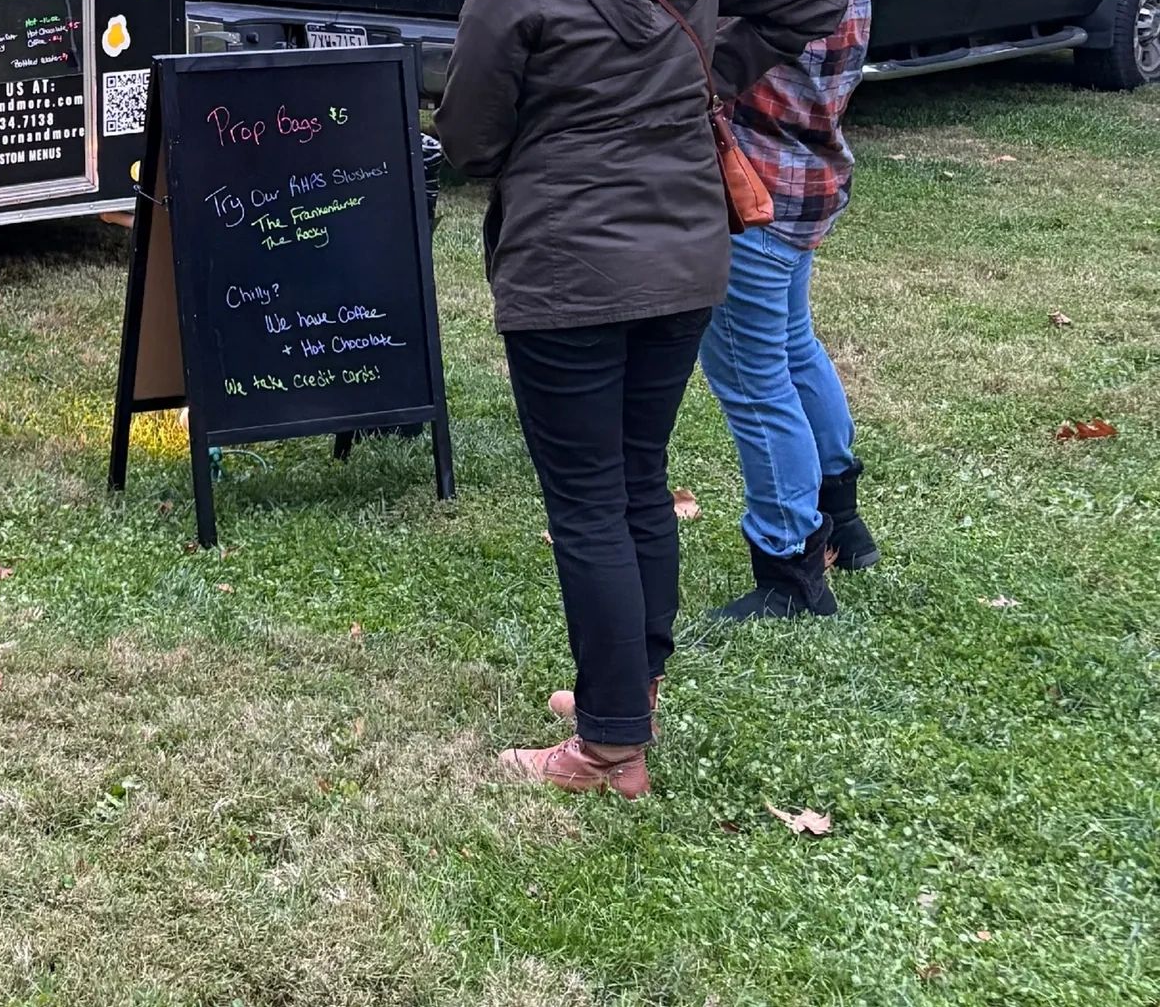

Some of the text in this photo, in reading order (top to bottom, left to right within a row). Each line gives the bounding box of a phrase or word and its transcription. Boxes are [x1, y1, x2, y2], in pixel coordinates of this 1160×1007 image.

[6, 82, 24, 96] US
[32, 79, 56, 95] AT:
[206, 106, 266, 146] Prop
[328, 106, 348, 124] $5
[28, 147, 61, 162] MENUS
[205, 161, 389, 228] Try Our RHPS Slushies!
[251, 213, 289, 232] The
[261, 226, 329, 250] The Rocky
[226, 283, 280, 309] Chilly?
[264, 305, 387, 334] We have Coffee
[301, 339, 326, 358] Hot
[331, 333, 407, 354] Chocolate
[224, 378, 248, 396] We
[253, 374, 289, 391] take
